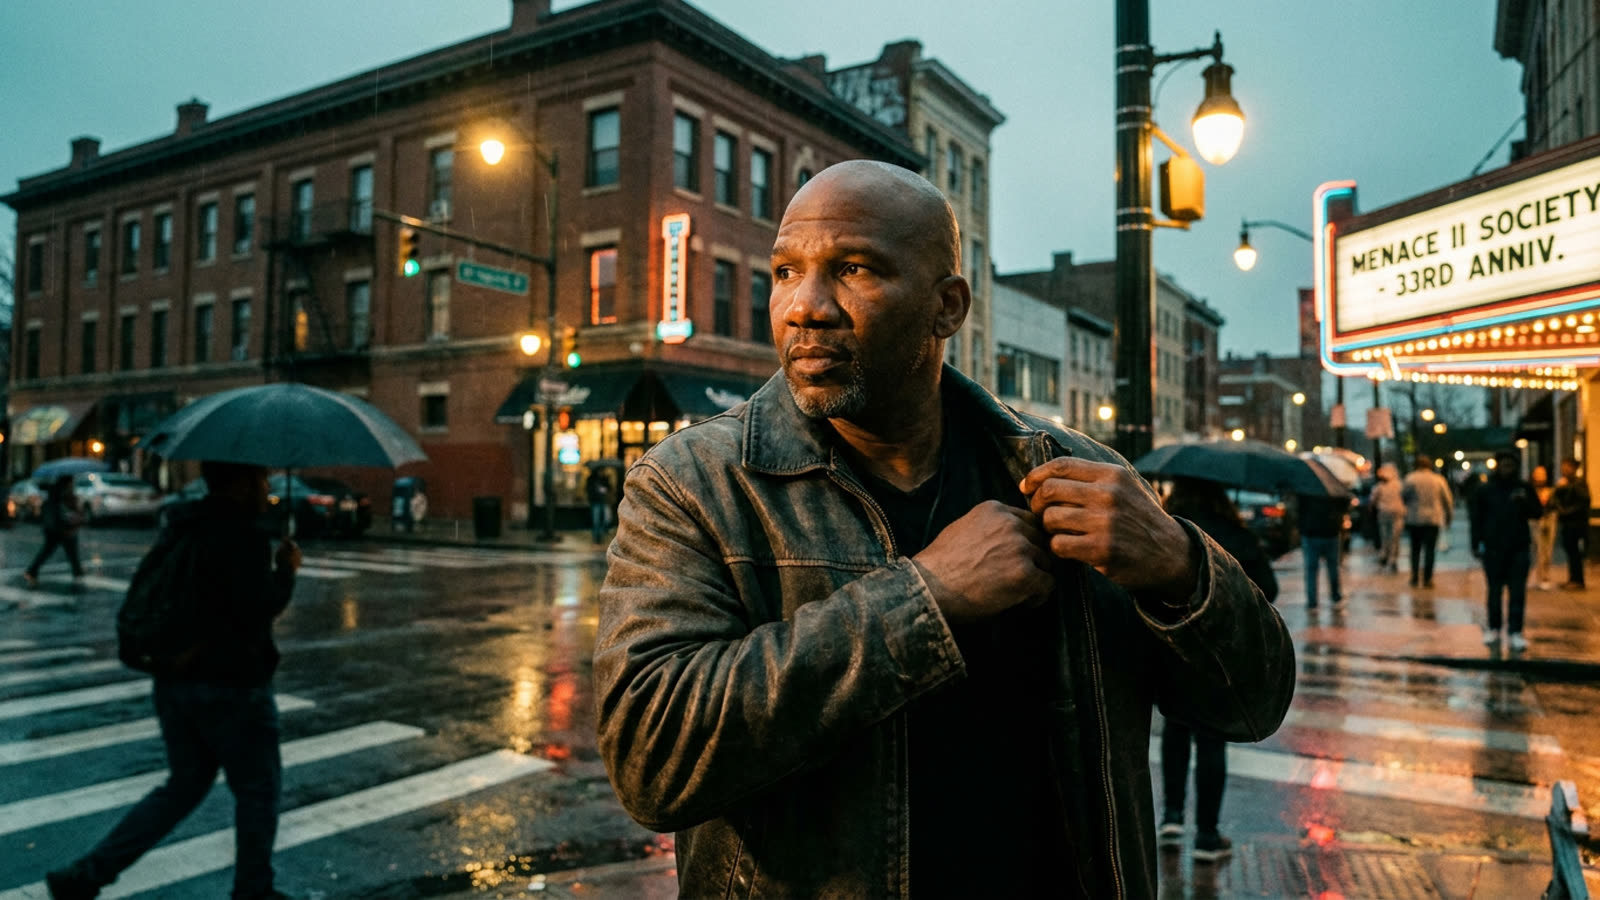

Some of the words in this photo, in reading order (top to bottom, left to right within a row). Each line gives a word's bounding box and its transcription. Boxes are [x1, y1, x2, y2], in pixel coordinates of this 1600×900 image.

[1352, 231, 1438, 274] MENACE
[1451, 222, 1466, 249] II
[1480, 183, 1600, 241] SOCIETY
[1396, 263, 1454, 296] 33RD
[1468, 235, 1564, 280] ANNIV.
